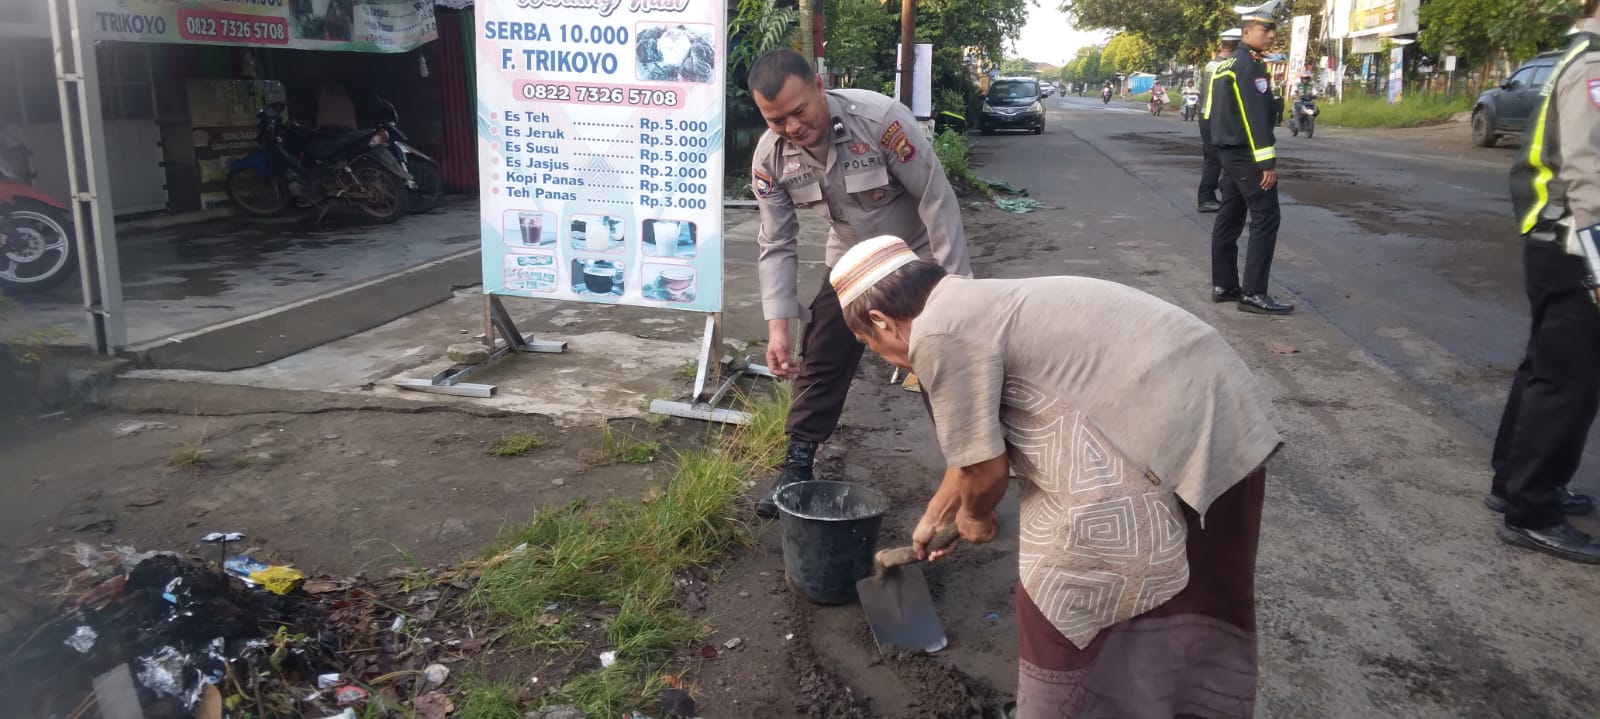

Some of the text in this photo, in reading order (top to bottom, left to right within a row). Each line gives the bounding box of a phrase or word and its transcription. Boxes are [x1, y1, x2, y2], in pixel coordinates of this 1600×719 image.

[96, 12, 166, 35] TRIKOYO
[186, 16, 285, 40] 0822 7326 5708
[485, 21, 629, 45] SERBA 10.000
[502, 49, 618, 75] F. TRIKOYO
[522, 84, 678, 107] 0822 7326 5708
[505, 111, 708, 132] Es Teh Rp.5.000
[505, 126, 708, 148] Es Jeruk Rp.5.000
[505, 141, 708, 163] Es Susu Rp.5.000
[844, 156, 882, 170] POLRI
[506, 157, 707, 179] Es Jasjus Rp.2.000
[506, 172, 707, 194] Kopi Panas Rp.5.000
[506, 187, 707, 209] Teh Panas Rp.3.000
